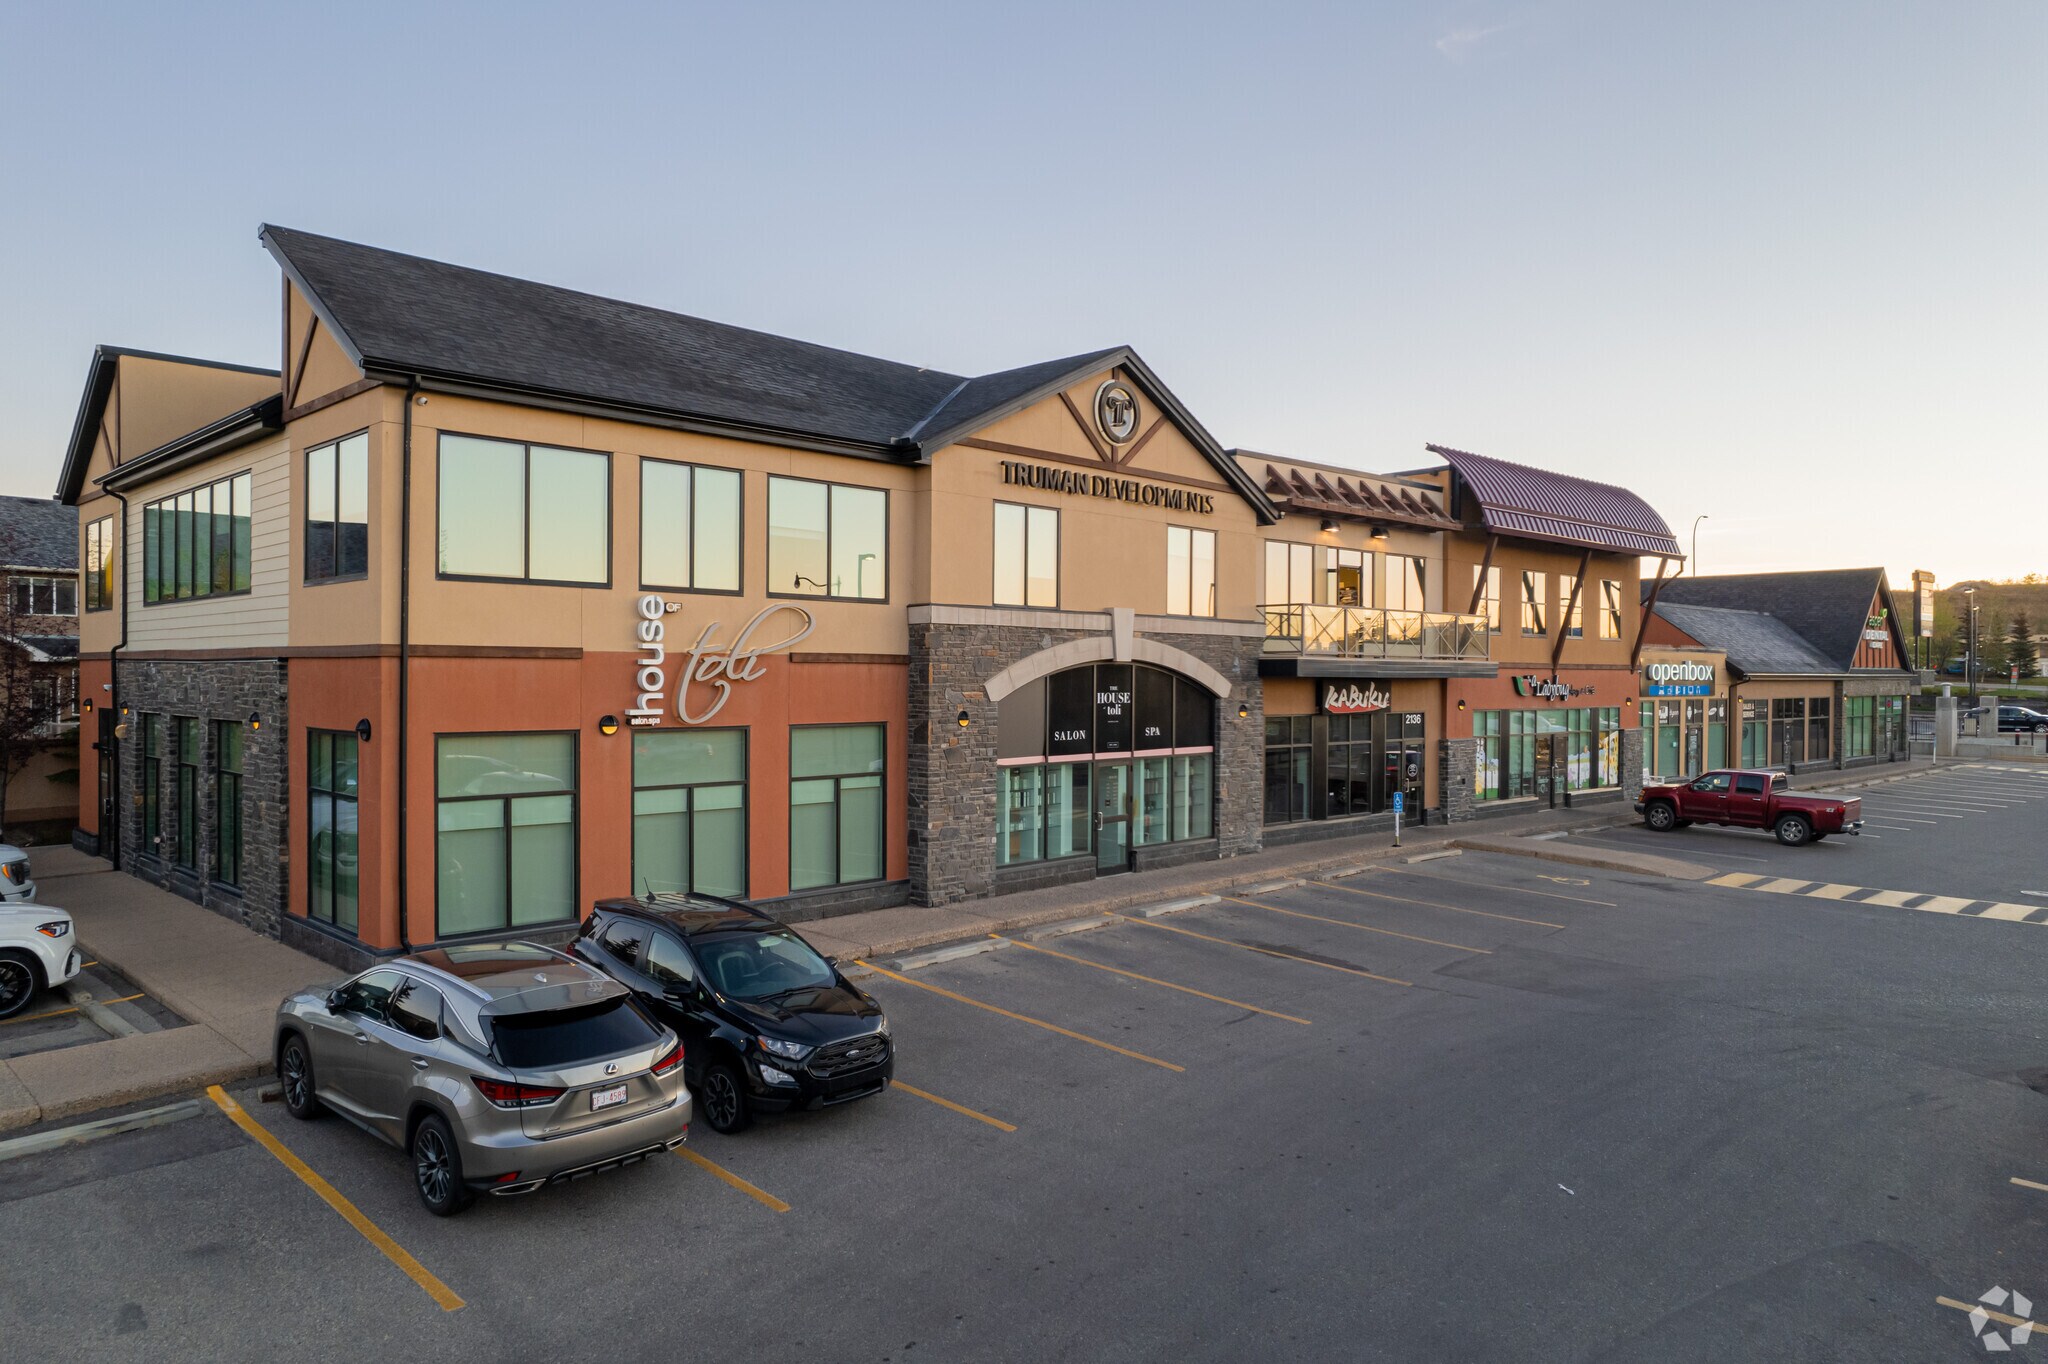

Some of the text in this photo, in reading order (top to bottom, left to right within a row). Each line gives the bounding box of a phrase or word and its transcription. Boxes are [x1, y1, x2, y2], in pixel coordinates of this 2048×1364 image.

[1001, 460, 1214, 515] TRUMAN DEVELOPMENTS
[664, 602, 682, 613] OF
[1865, 630, 1889, 641] DENTAL
[625, 594, 663, 715] house
[675, 601, 816, 725] toli
[1652, 660, 1714, 686] openbox
[1536, 674, 1570, 702] Ladybug
[1097, 692, 1131, 704] HOUSE
[1107, 704, 1121, 715] toli
[1405, 714, 1422, 724] 2136
[1054, 729, 1086, 742] SALON
[1145, 726, 1161, 737] SPA
